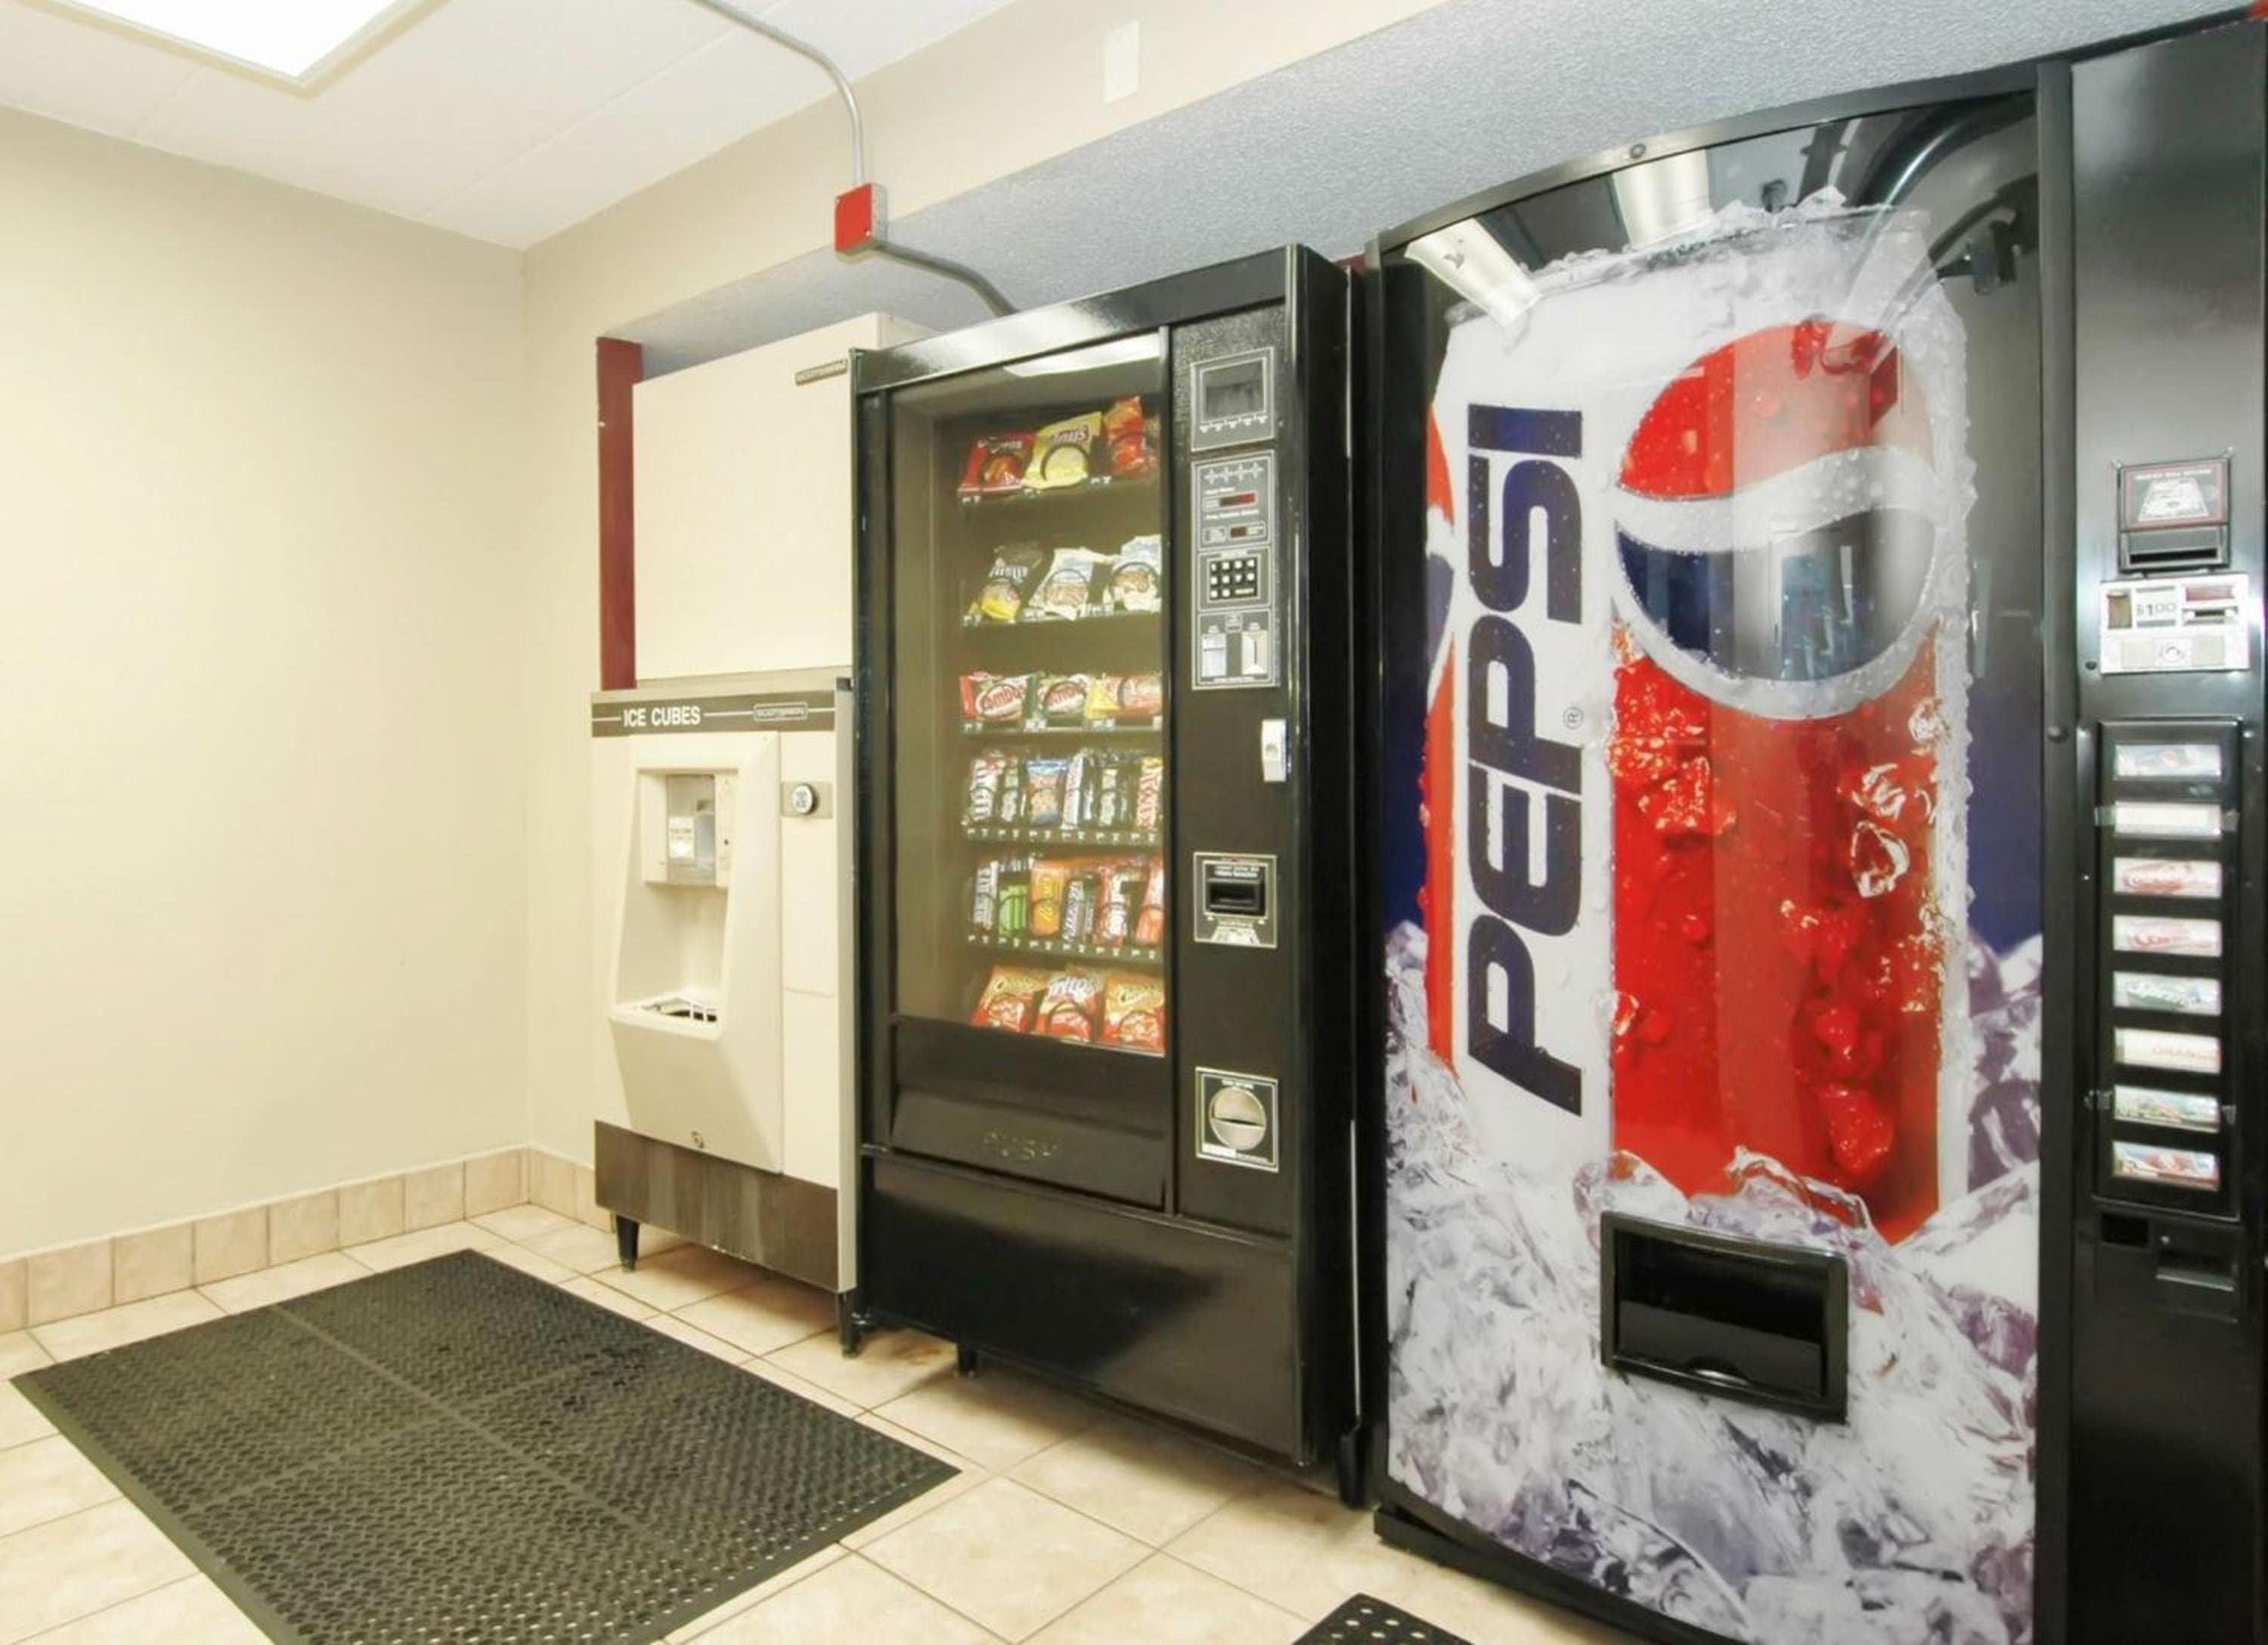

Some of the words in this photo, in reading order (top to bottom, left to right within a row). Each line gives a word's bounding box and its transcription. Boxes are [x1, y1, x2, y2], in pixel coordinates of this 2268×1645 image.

[623, 708, 647, 726] ICE
[651, 705, 701, 726] CUBES
[1467, 403, 1582, 1117] PEPSI
